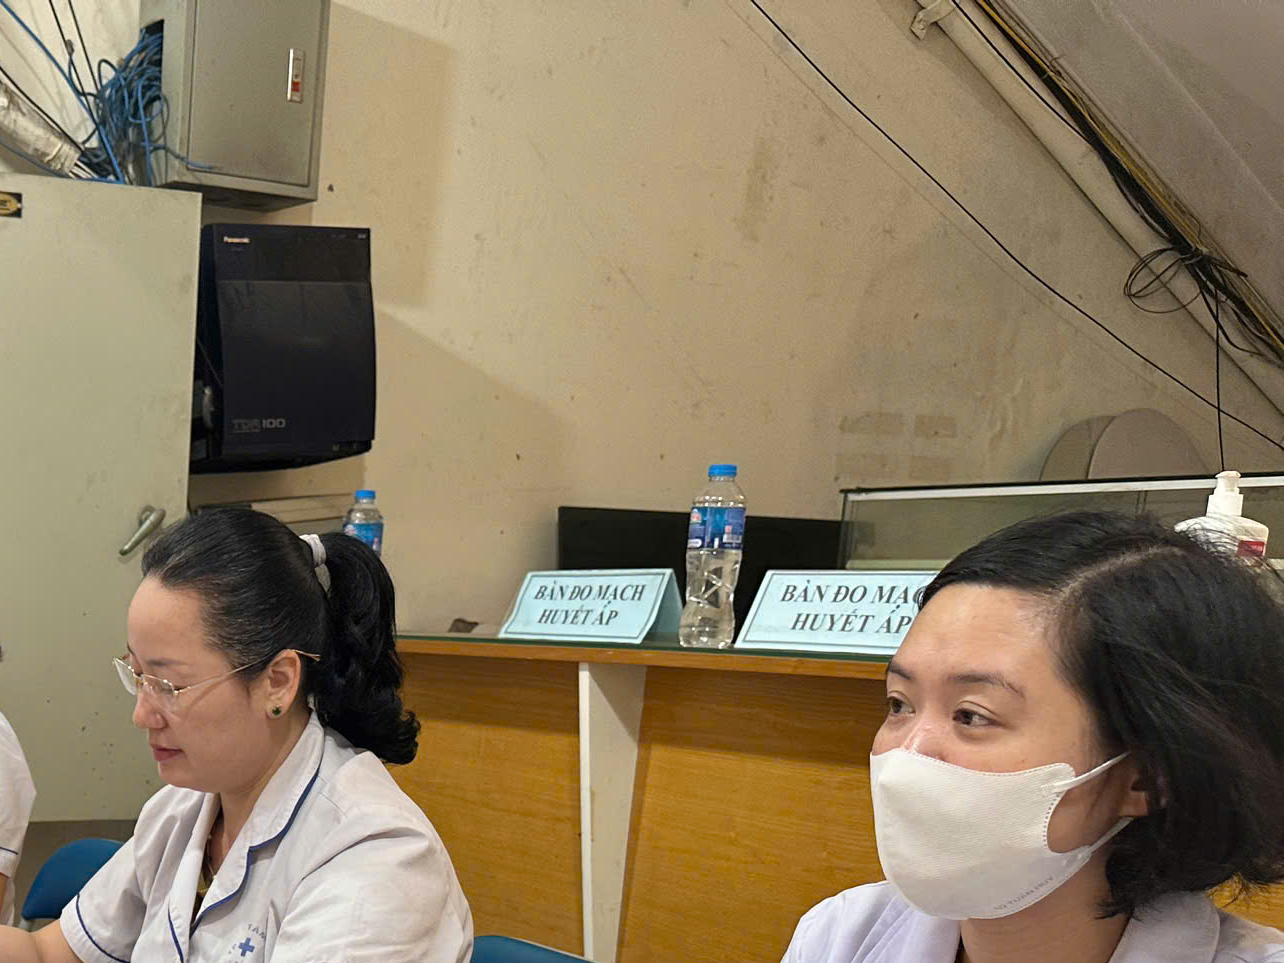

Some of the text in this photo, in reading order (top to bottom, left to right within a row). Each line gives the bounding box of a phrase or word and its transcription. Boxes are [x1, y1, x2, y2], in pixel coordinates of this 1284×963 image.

[534, 580, 647, 604] BÀN ĐO MẠCH
[780, 580, 830, 602] BÀN
[831, 585, 866, 603] ĐO
[537, 604, 593, 625] HUYẾT
[790, 605, 912, 634] HUYẾT ÁP
